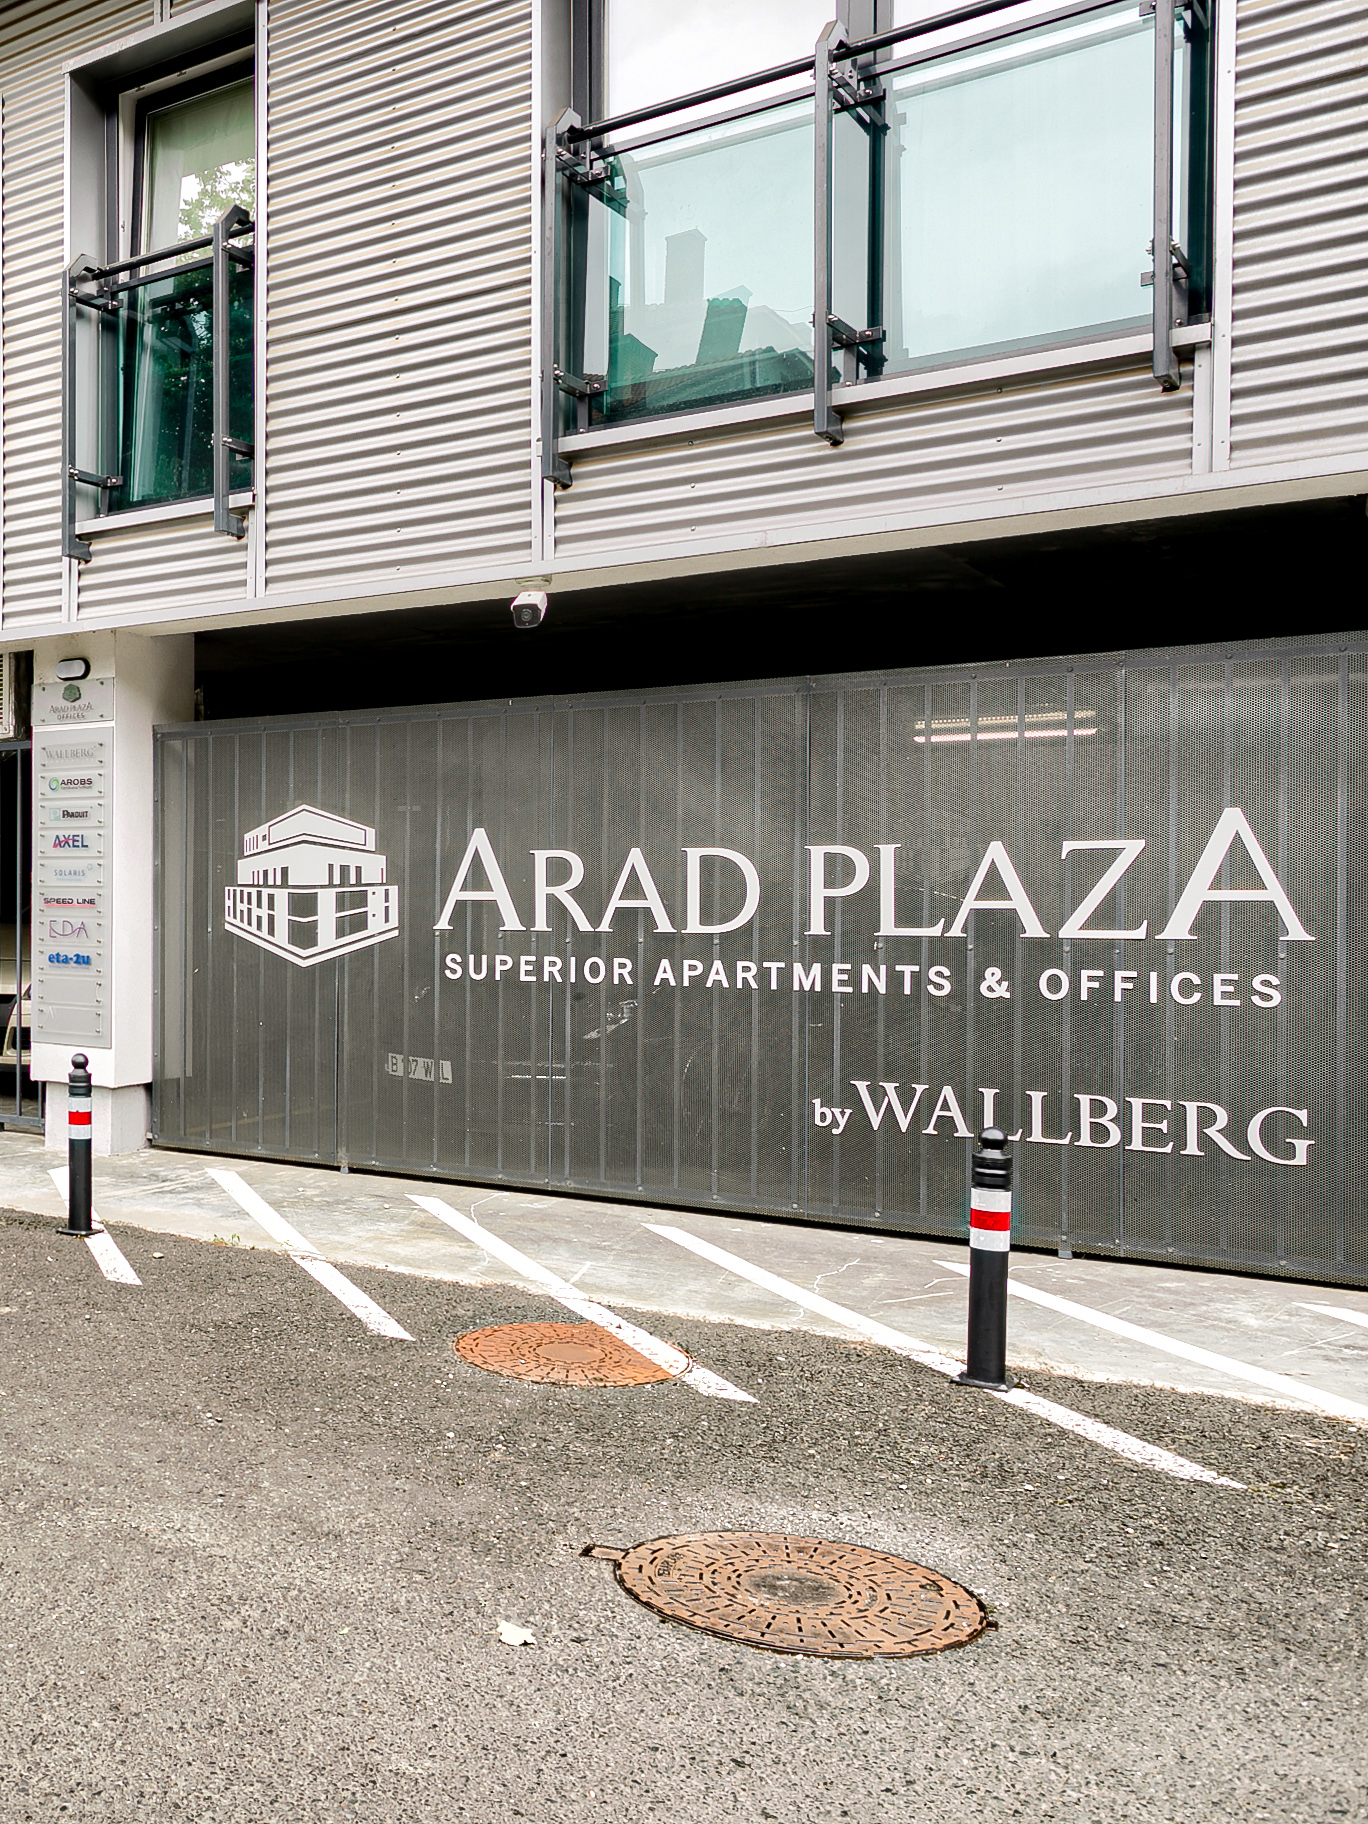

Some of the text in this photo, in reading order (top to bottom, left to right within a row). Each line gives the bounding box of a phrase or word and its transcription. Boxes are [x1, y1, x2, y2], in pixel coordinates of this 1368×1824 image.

[57, 712, 85, 720] OFFICES
[45, 748, 94, 759] WALLBERG
[60, 778, 93, 786] AROBS
[52, 834, 89, 848] AXEL
[54, 869, 86, 877] SOLARIS
[432, 806, 1317, 941] ARAD PLAZA
[48, 952, 91, 965] eta-2u
[444, 953, 1282, 1008] SUPERIOR APARTMENTS & OFFICES
[391, 1055, 398, 1072] B
[812, 1080, 1316, 1166] by WALLBERG
